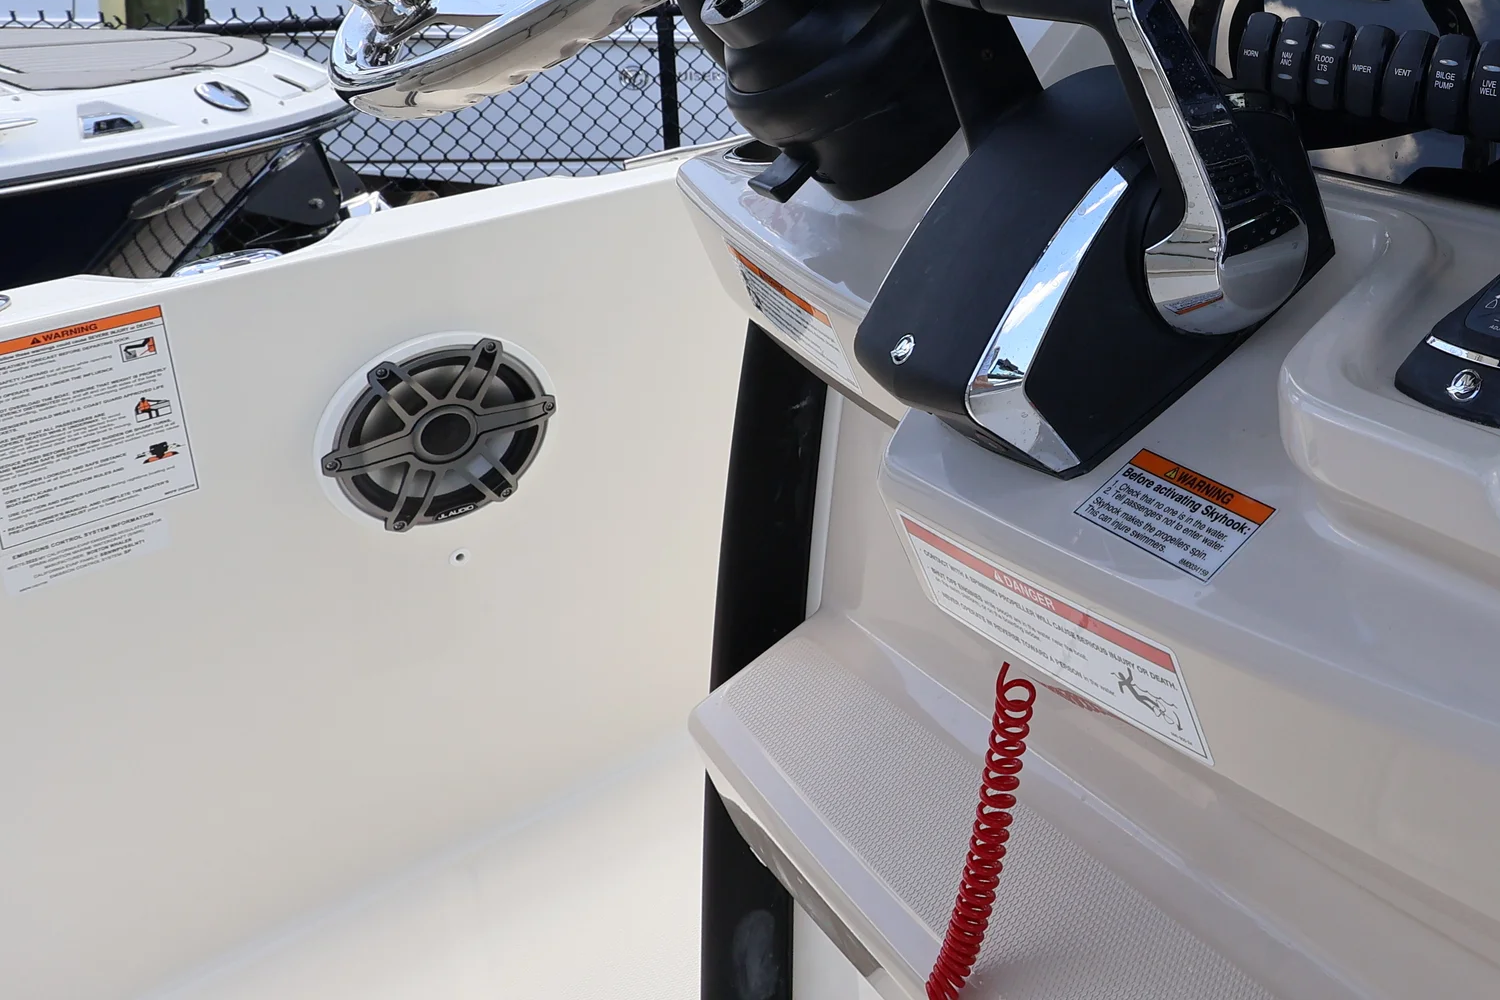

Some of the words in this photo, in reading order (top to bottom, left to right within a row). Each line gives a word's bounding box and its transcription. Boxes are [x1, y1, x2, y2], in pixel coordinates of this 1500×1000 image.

[1243, 48, 1259, 58] HORN
[1281, 51, 1293, 59] NAV
[1280, 58, 1292, 67] ANC
[1314, 54, 1334, 64] FLOOD
[1317, 63, 1328, 72] LTS
[1352, 64, 1372, 74] WIPER
[1394, 68, 1412, 77] VENT
[1436, 71, 1456, 81] BILGE
[1434, 80, 1454, 90] PUMP
[1482, 79, 1497, 89] LIVE
[1479, 87, 1497, 97] WELL
[41, 322, 98, 342] WARNING
[1173, 470, 1237, 505] WARNING
[1120, 466, 1158, 489] Before
[1149, 481, 1205, 513] activating
[1196, 504, 1254, 538] Skyhook:
[449, 504, 474, 516] AUDIO
[1110, 478, 1122, 488] 1.
[1116, 482, 1143, 498] Check
[1138, 492, 1157, 505] that
[1151, 499, 1167, 510] no
[1161, 504, 1181, 517] one
[1175, 510, 1188, 521] is
[1183, 514, 1196, 524] in
[1191, 518, 1209, 531] the
[1203, 524, 1232, 542] water.
[1101, 485, 1114, 495] 2.
[1108, 489, 1127, 502] Tell
[1120, 496, 1164, 522] passengers
[1160, 514, 1178, 527] not
[1172, 520, 1186, 531] to
[1180, 524, 1206, 541] enter
[1200, 534, 1228, 552] water.
[1081, 503, 1102, 518] This
[1096, 511, 1115, 524] can
[1107, 517, 1134, 535] injure
[1127, 527, 1171, 553] swimmers.
[1088, 495, 1125, 518] Skyhook
[1118, 509, 1147, 528] makes
[1140, 521, 1159, 534] the
[1151, 527, 1193, 553] propellers
[1186, 544, 1211, 562] spin.
[11, 544, 49, 560] EMISSIONS
[49, 533, 83, 548] CONTROL
[83, 525, 110, 537] SYSTEM
[110, 511, 154, 528] INFORMATION
[1002, 574, 1056, 612] DANGER
[1148, 669, 1179, 693] DEATH.
